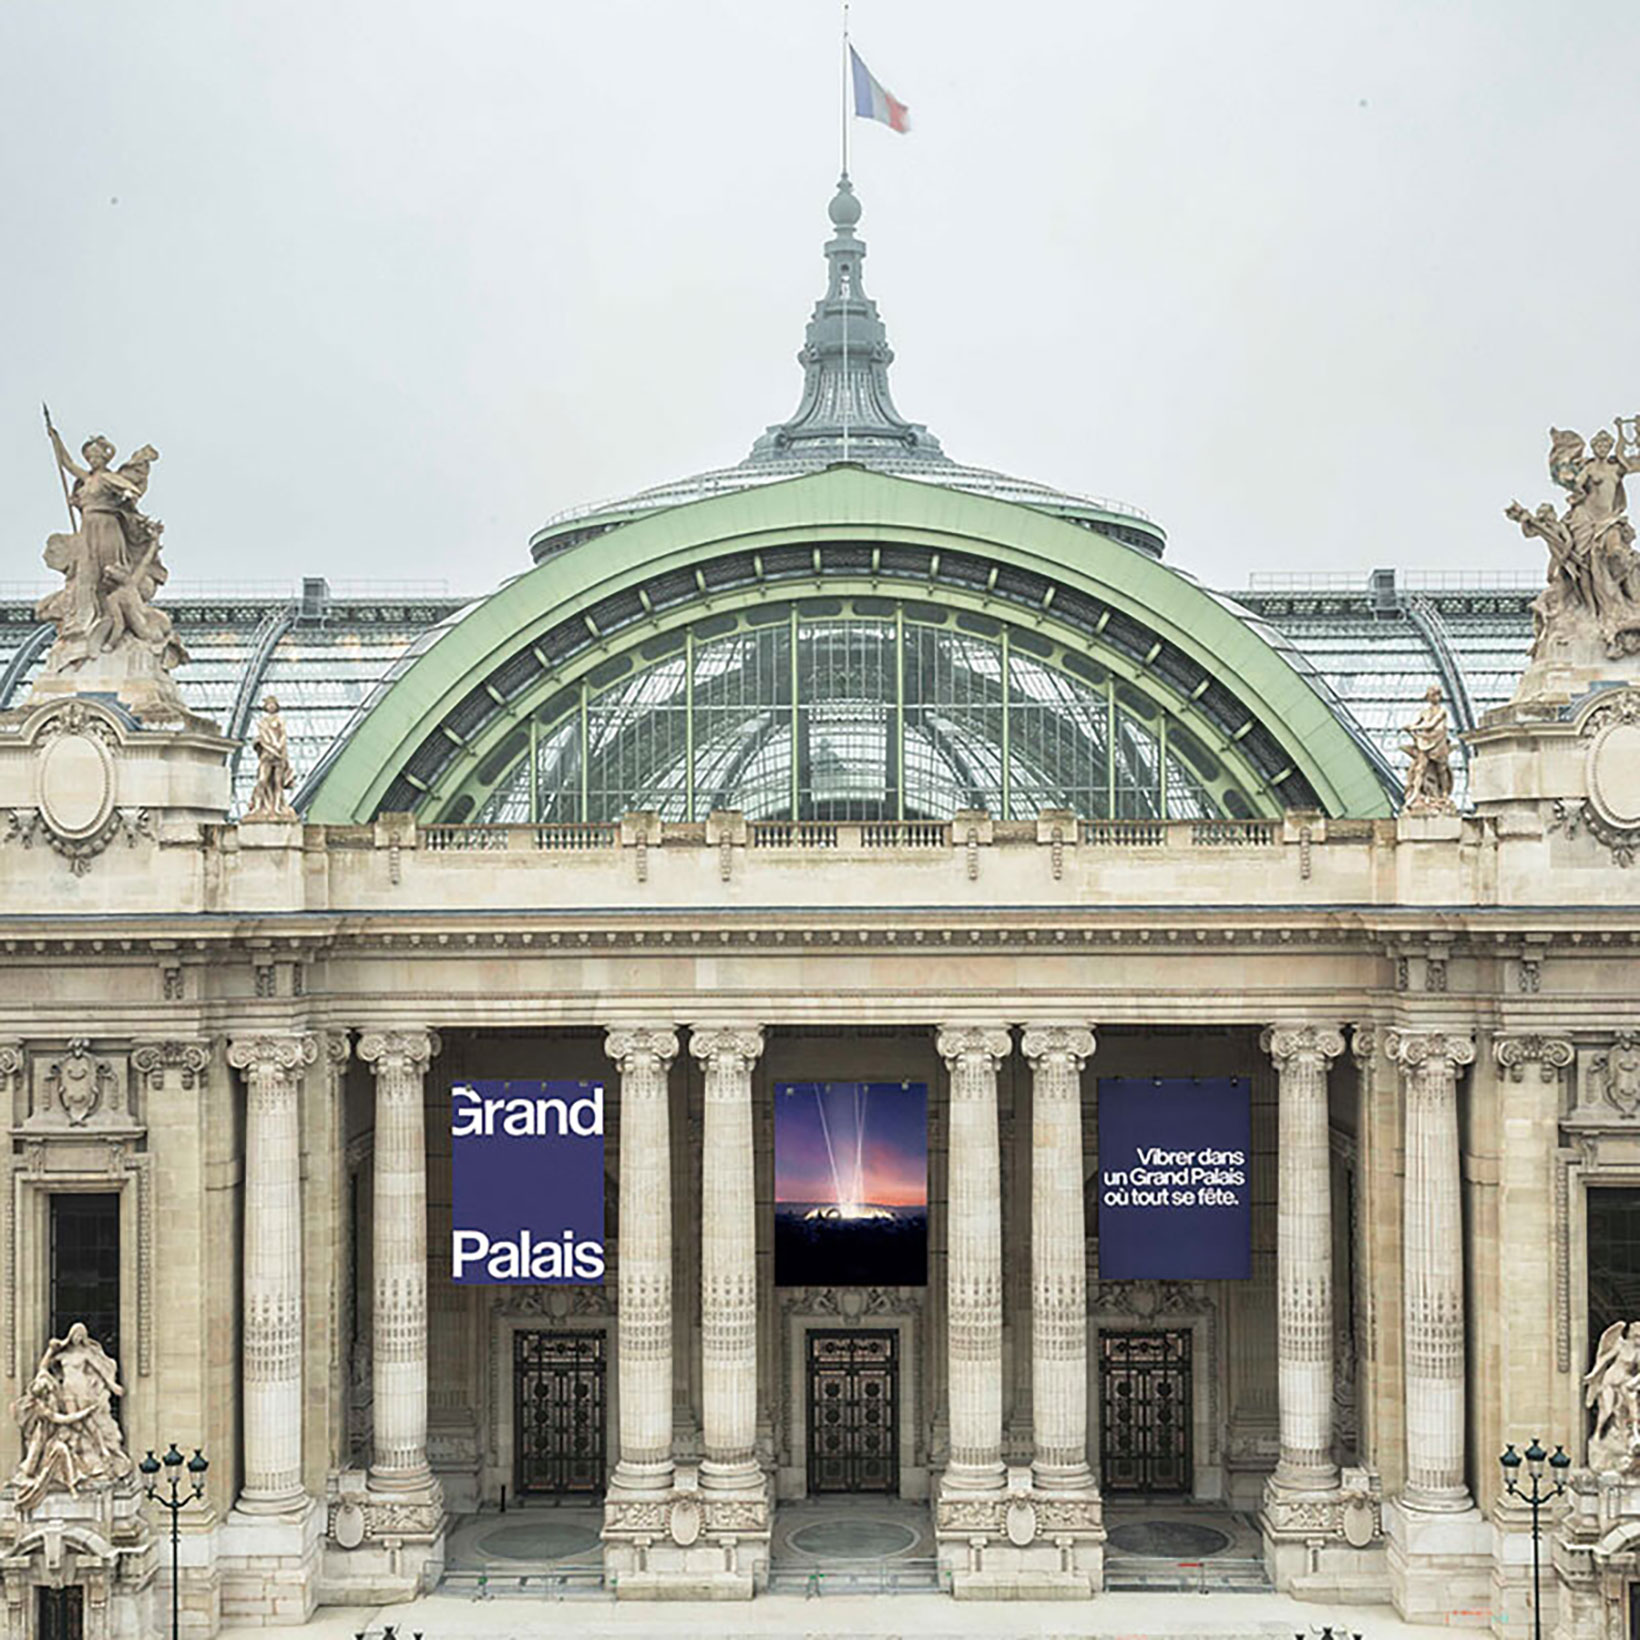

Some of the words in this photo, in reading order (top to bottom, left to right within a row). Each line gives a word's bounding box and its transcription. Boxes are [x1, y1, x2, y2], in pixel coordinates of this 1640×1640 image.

[451, 1086, 604, 1136] Grand
[1137, 1147, 1196, 1166] Vibrer
[1198, 1147, 1245, 1166] dans
[1104, 1171, 1127, 1186] un
[1130, 1167, 1189, 1186] Grand
[1192, 1167, 1245, 1186] Palais
[1104, 1188, 1129, 1206] où
[1132, 1188, 1170, 1206] tout
[1172, 1190, 1196, 1206] se
[1198, 1187, 1239, 1206] fête.
[452, 1230, 605, 1279] Palais
